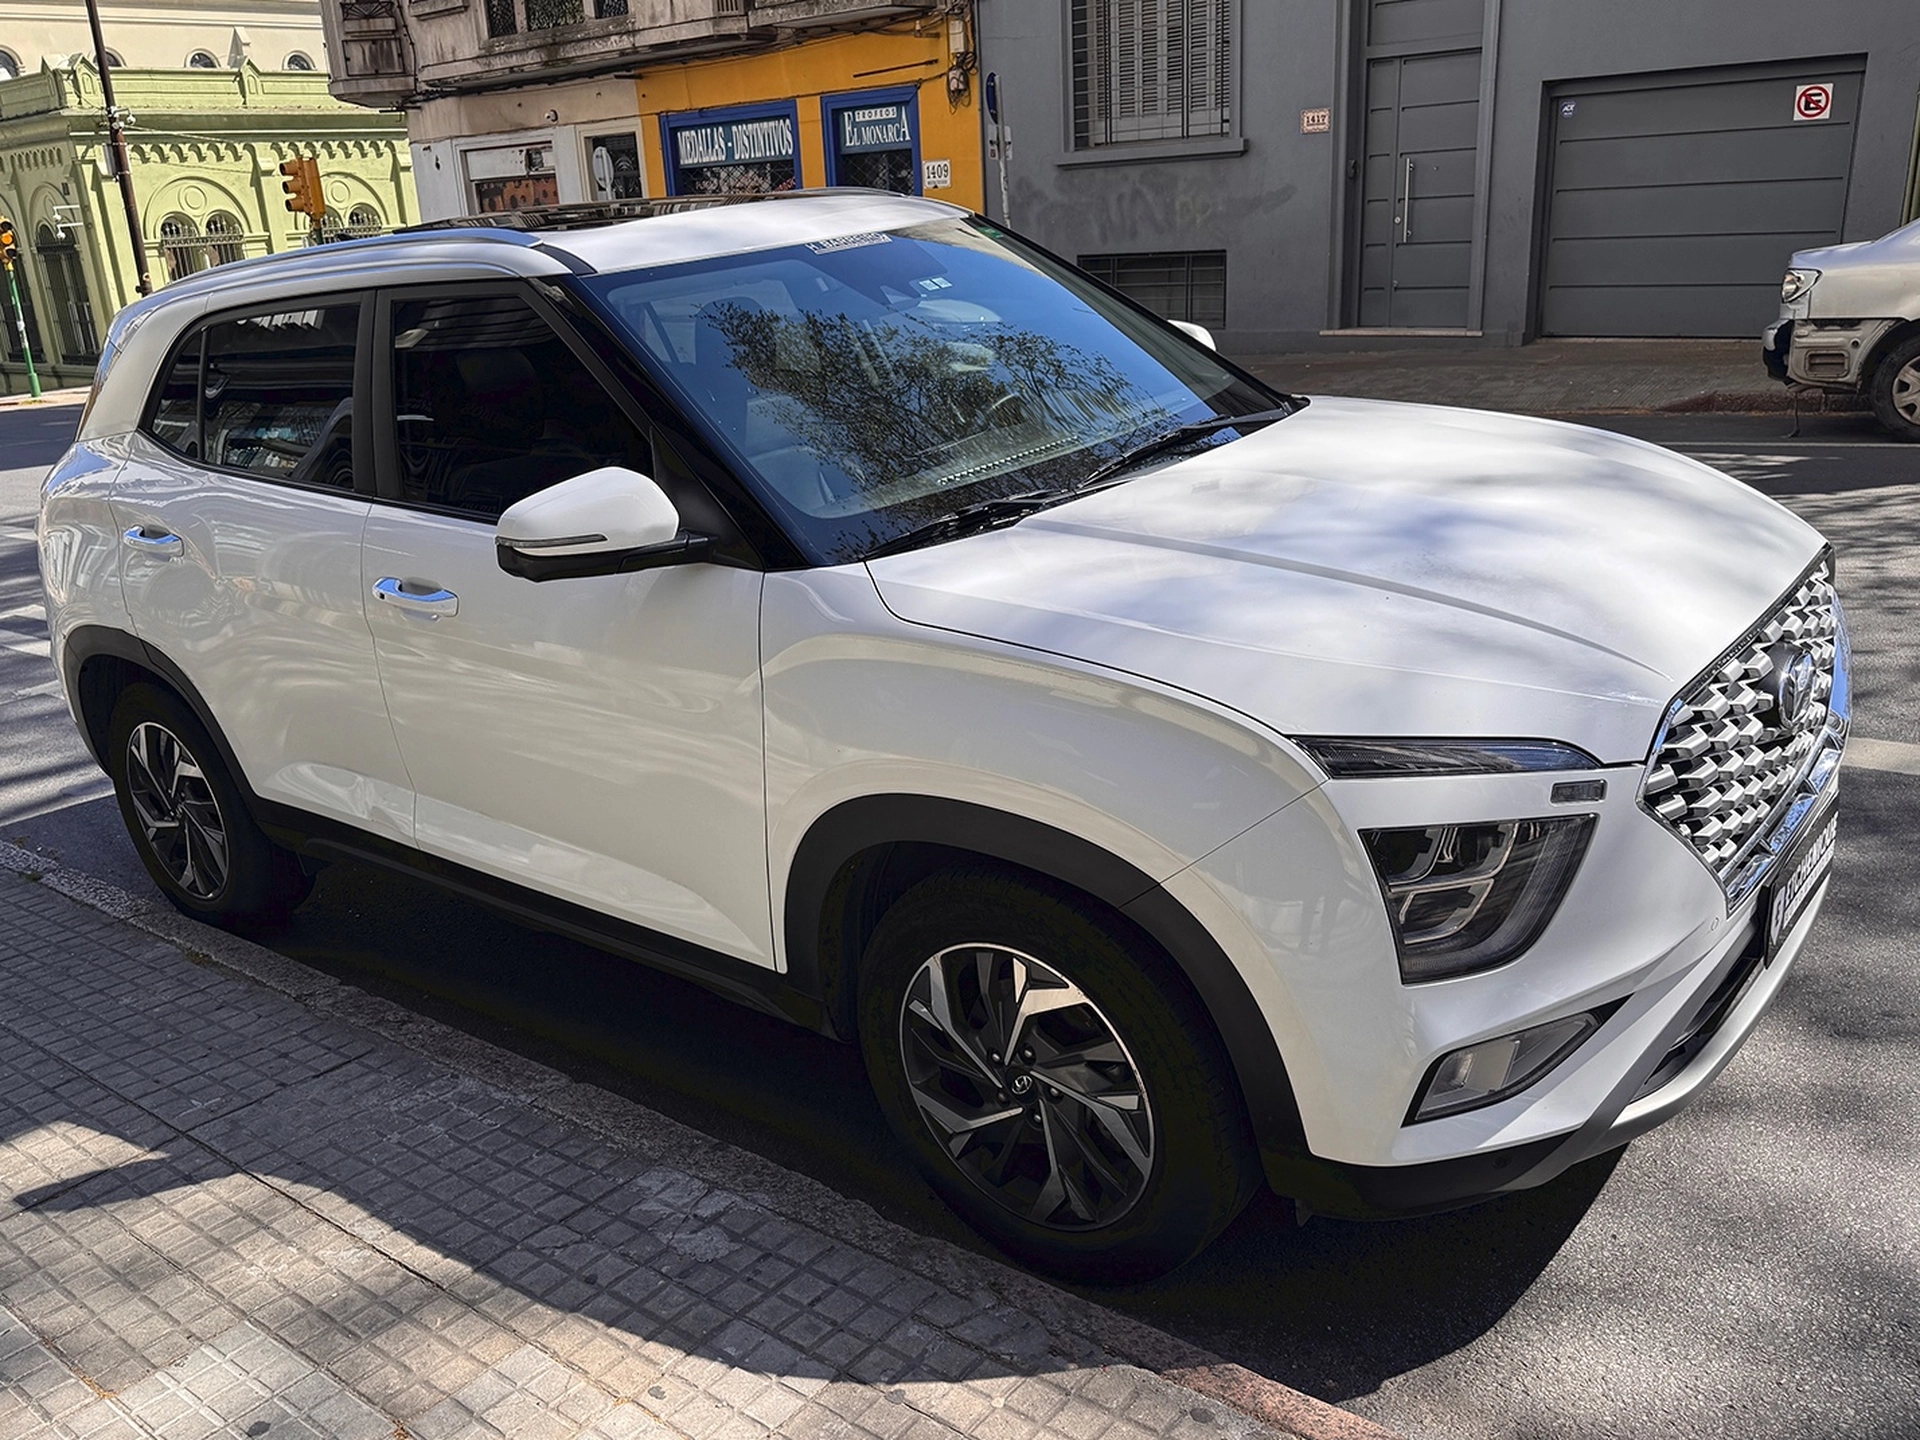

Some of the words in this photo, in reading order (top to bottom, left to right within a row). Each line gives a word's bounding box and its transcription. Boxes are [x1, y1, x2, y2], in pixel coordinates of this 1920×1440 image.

[855, 107, 896, 120] TROFEOS
[1306, 114, 1326, 123] 1417
[843, 111, 861, 147] EL
[861, 105, 911, 145] MONARCA
[677, 126, 726, 165] MEDALLAS
[732, 118, 794, 160] DISTINTIVOS
[926, 163, 949, 179] 1409
